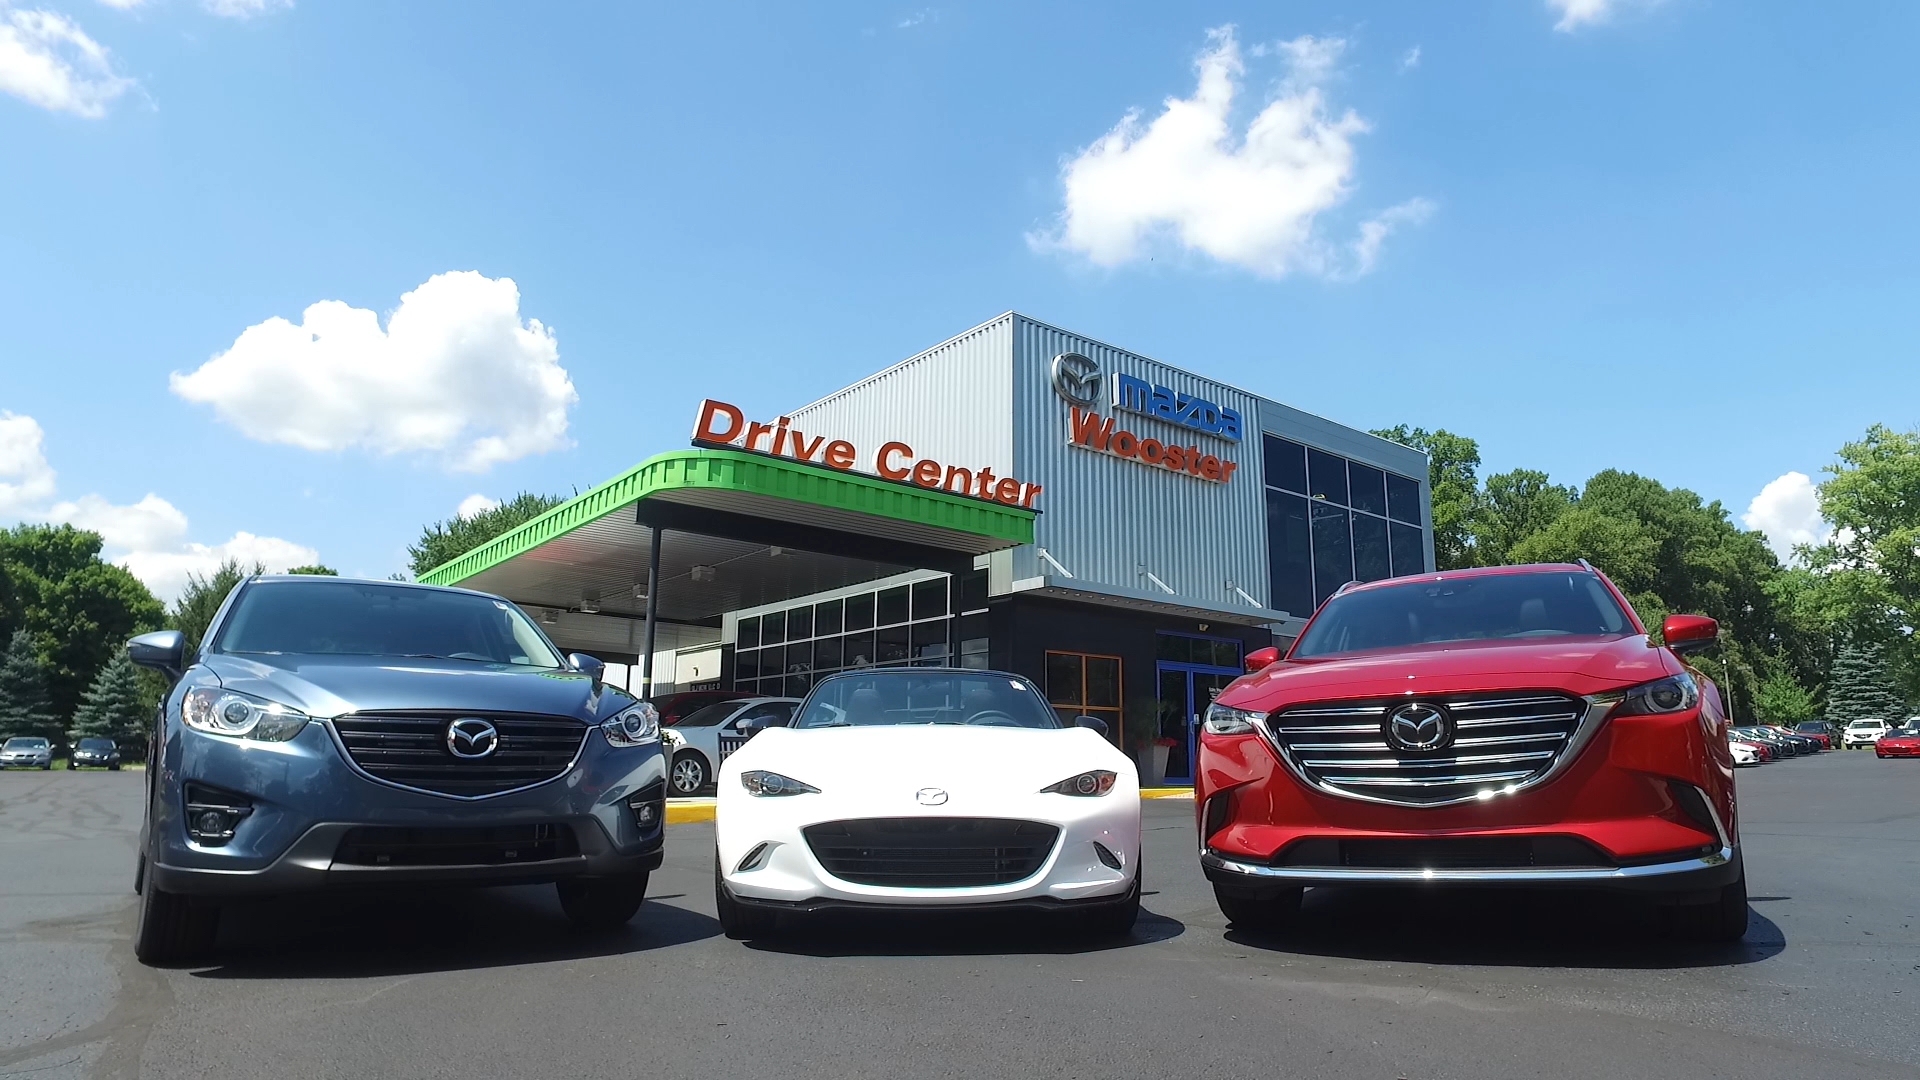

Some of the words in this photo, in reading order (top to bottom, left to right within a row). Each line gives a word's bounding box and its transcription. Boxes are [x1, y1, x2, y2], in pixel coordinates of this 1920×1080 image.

[694, 399, 856, 469] Drive
[874, 441, 1042, 507] Center
[1070, 406, 1237, 483] Wooster
